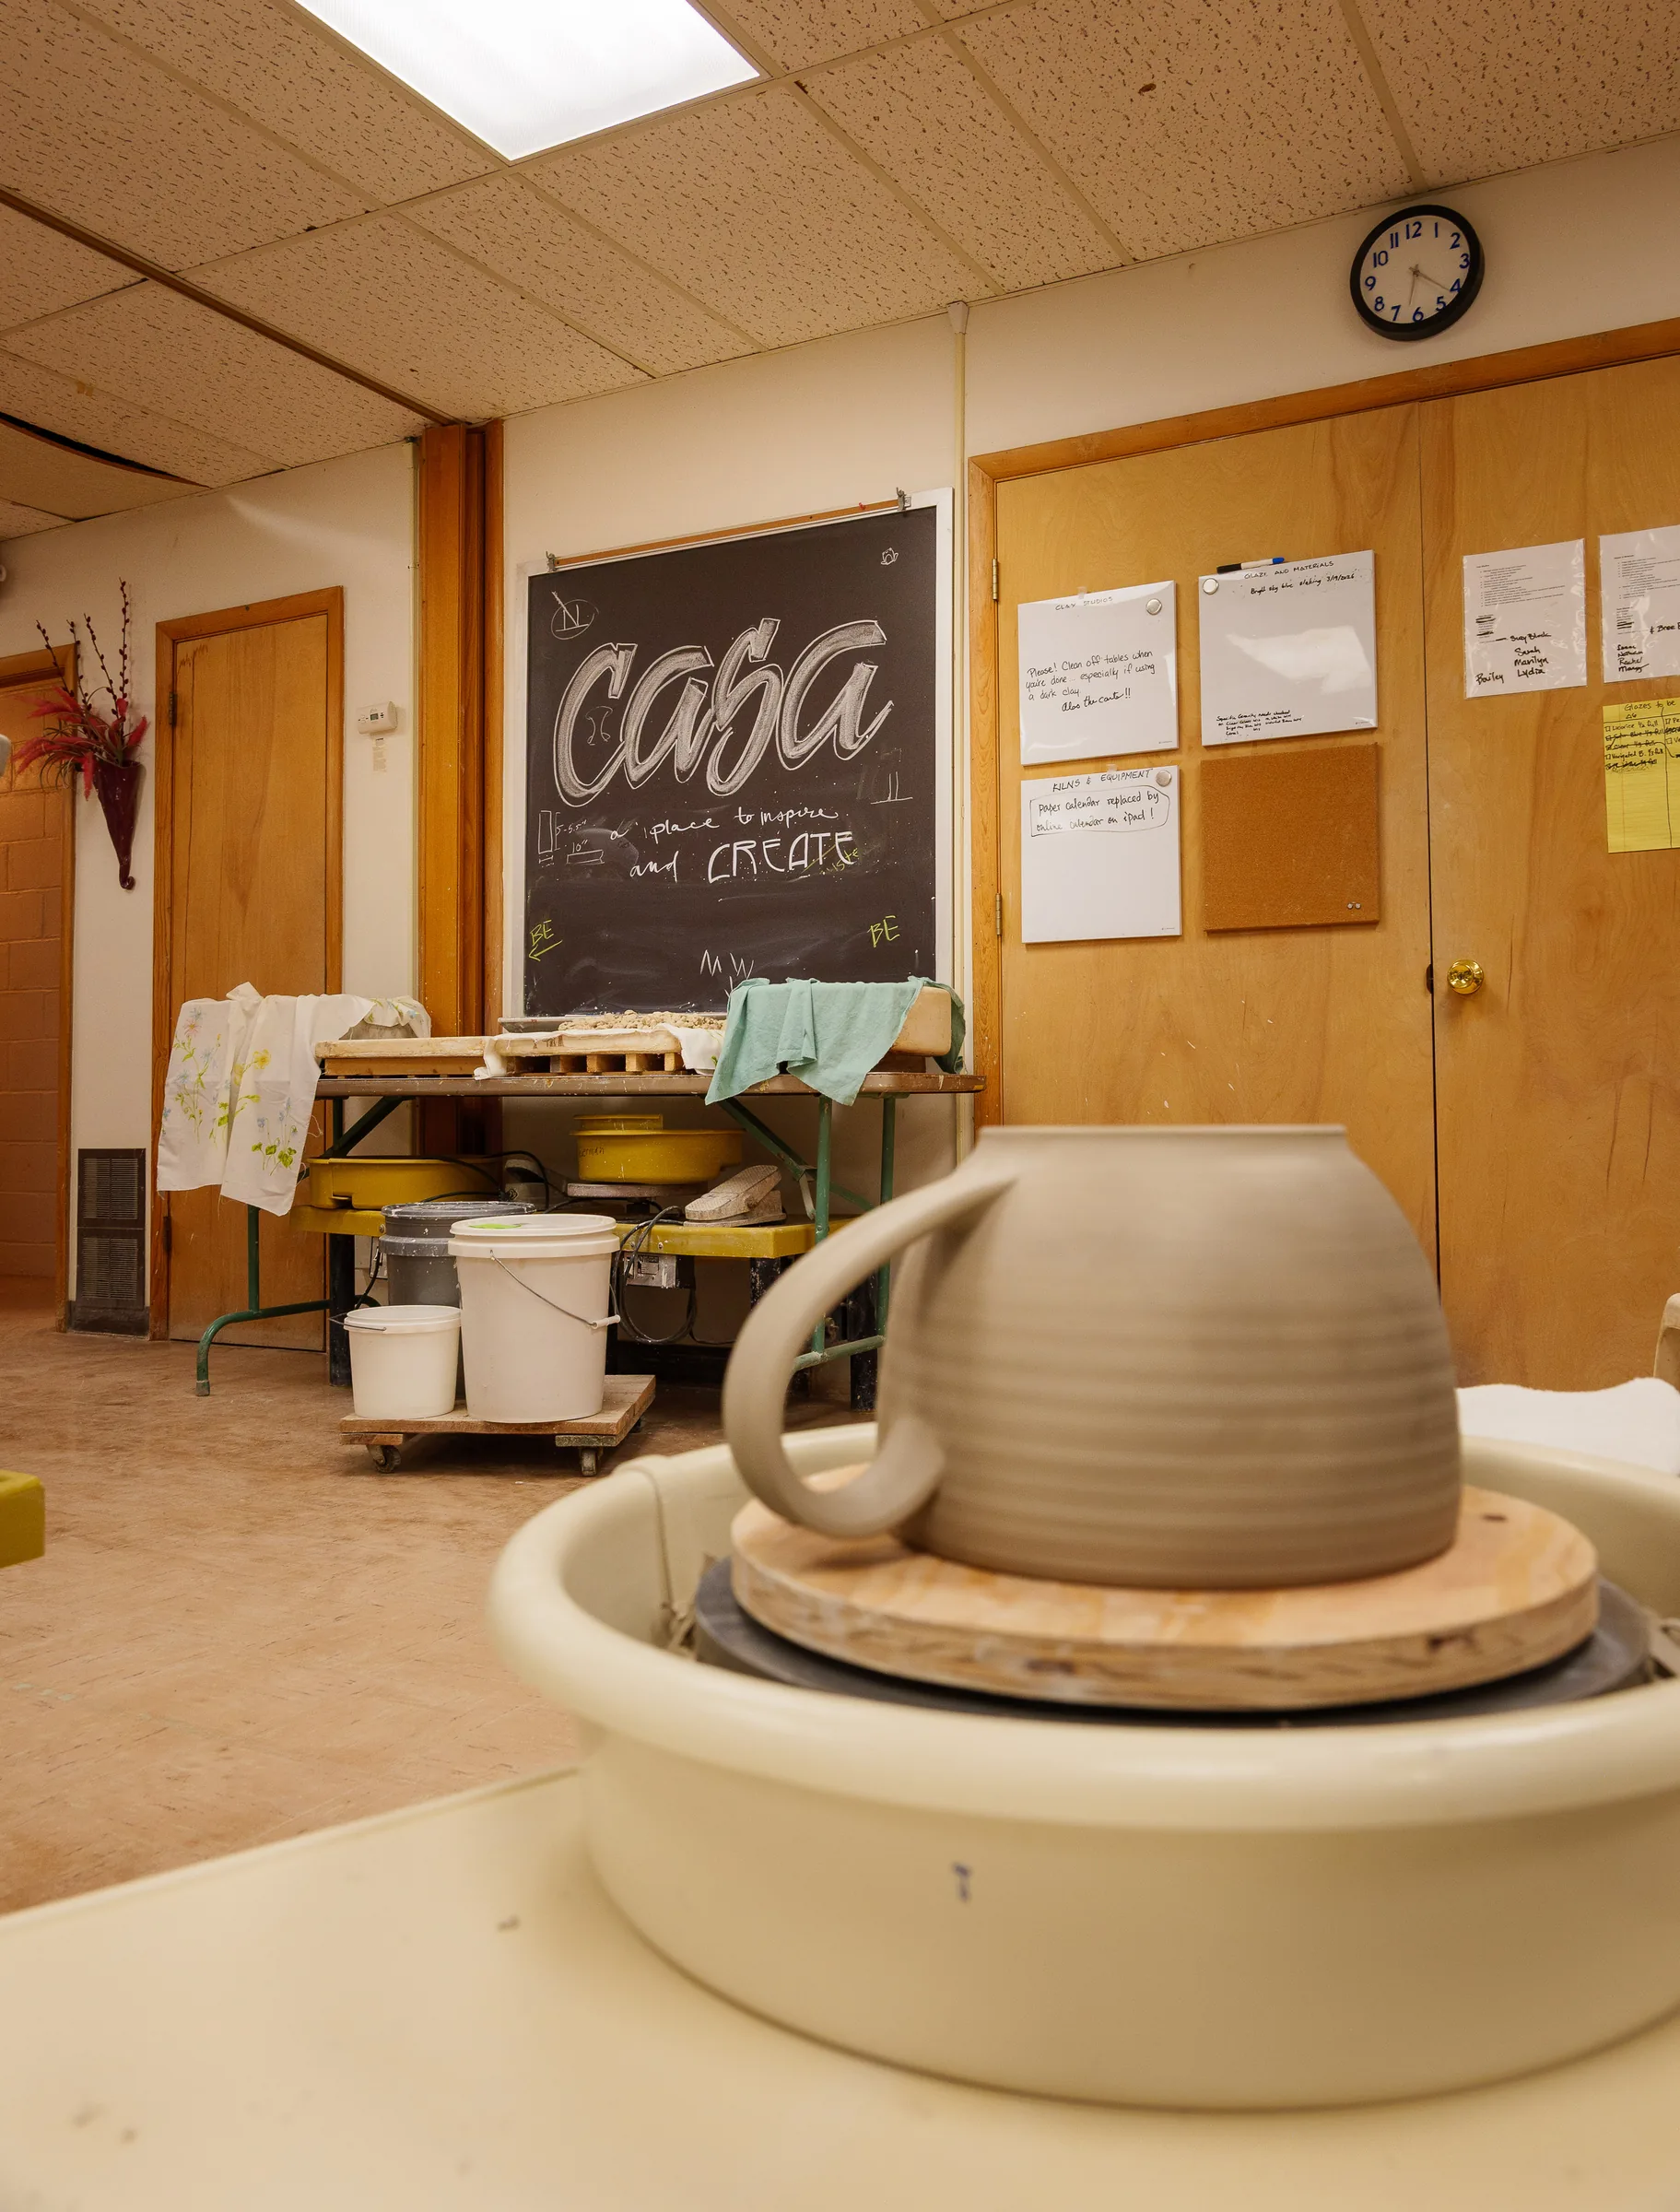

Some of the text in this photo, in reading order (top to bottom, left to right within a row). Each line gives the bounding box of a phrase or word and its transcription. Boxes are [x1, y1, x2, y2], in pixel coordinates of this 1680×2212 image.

[1405, 221, 1422, 240] 12
[1434, 222, 1439, 238] 1
[1390, 232, 1399, 249] 11
[1450, 232, 1461, 250] 2
[1373, 251, 1389, 268] 10
[1459, 253, 1470, 269] 3
[1365, 276, 1376, 291] 9
[1450, 278, 1462, 293] 4
[1374, 297, 1385, 312] 8
[1436, 296, 1447, 312] 5
[1391, 305, 1402, 322] 7
[1412, 307, 1424, 323] 6
[1084, 596, 1113, 606] STUDIOS
[1514, 646, 1541, 656] Sarah
[1027, 650, 1153, 677] Please! Clean off tables when
[1518, 667, 1545, 677] Lydia
[1080, 667, 1119, 683] especially
[1124, 663, 1133, 675] if
[1135, 664, 1156, 675] using
[1040, 689, 1057, 700] dark
[1052, 780, 1080, 792] KILNS
[1100, 769, 1153, 782] EQUIPMENT
[1065, 796, 1100, 810] calendar
[1107, 792, 1141, 808] replaced
[1147, 791, 1159, 805] by
[650, 818, 720, 844] place
[734, 806, 756, 825] to
[760, 807, 839, 828] inspire
[1036, 819, 1063, 832] online
[1070, 815, 1104, 829] calendar
[630, 831, 855, 883] and CREATE
[531, 919, 555, 946] BE
[868, 916, 900, 947] BE
